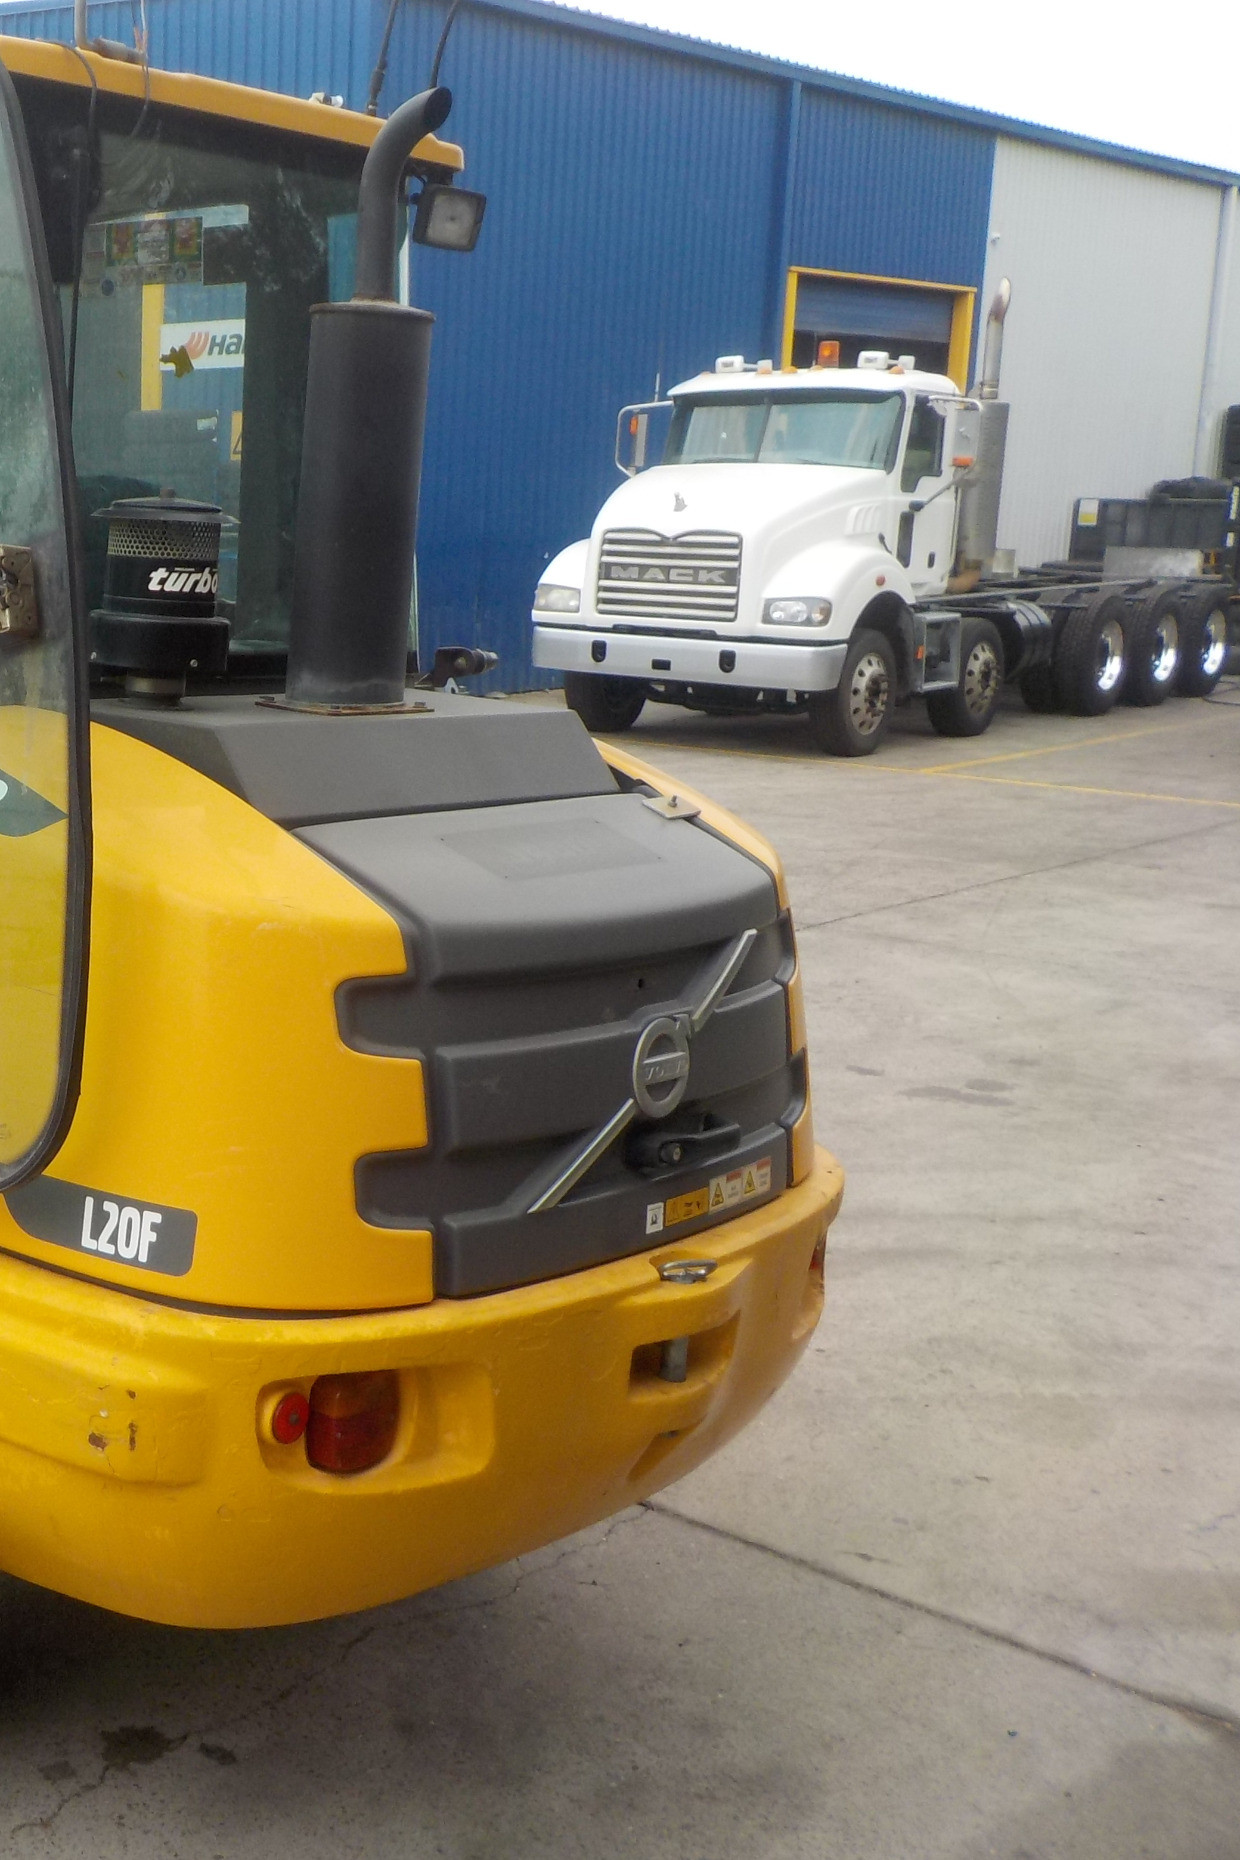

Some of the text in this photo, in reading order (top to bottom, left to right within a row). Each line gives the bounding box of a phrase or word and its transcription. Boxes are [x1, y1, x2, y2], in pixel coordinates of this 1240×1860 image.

[208, 333, 244, 355] Ha
[610, 566, 726, 583] MACK
[81, 1196, 162, 1263] L20F
